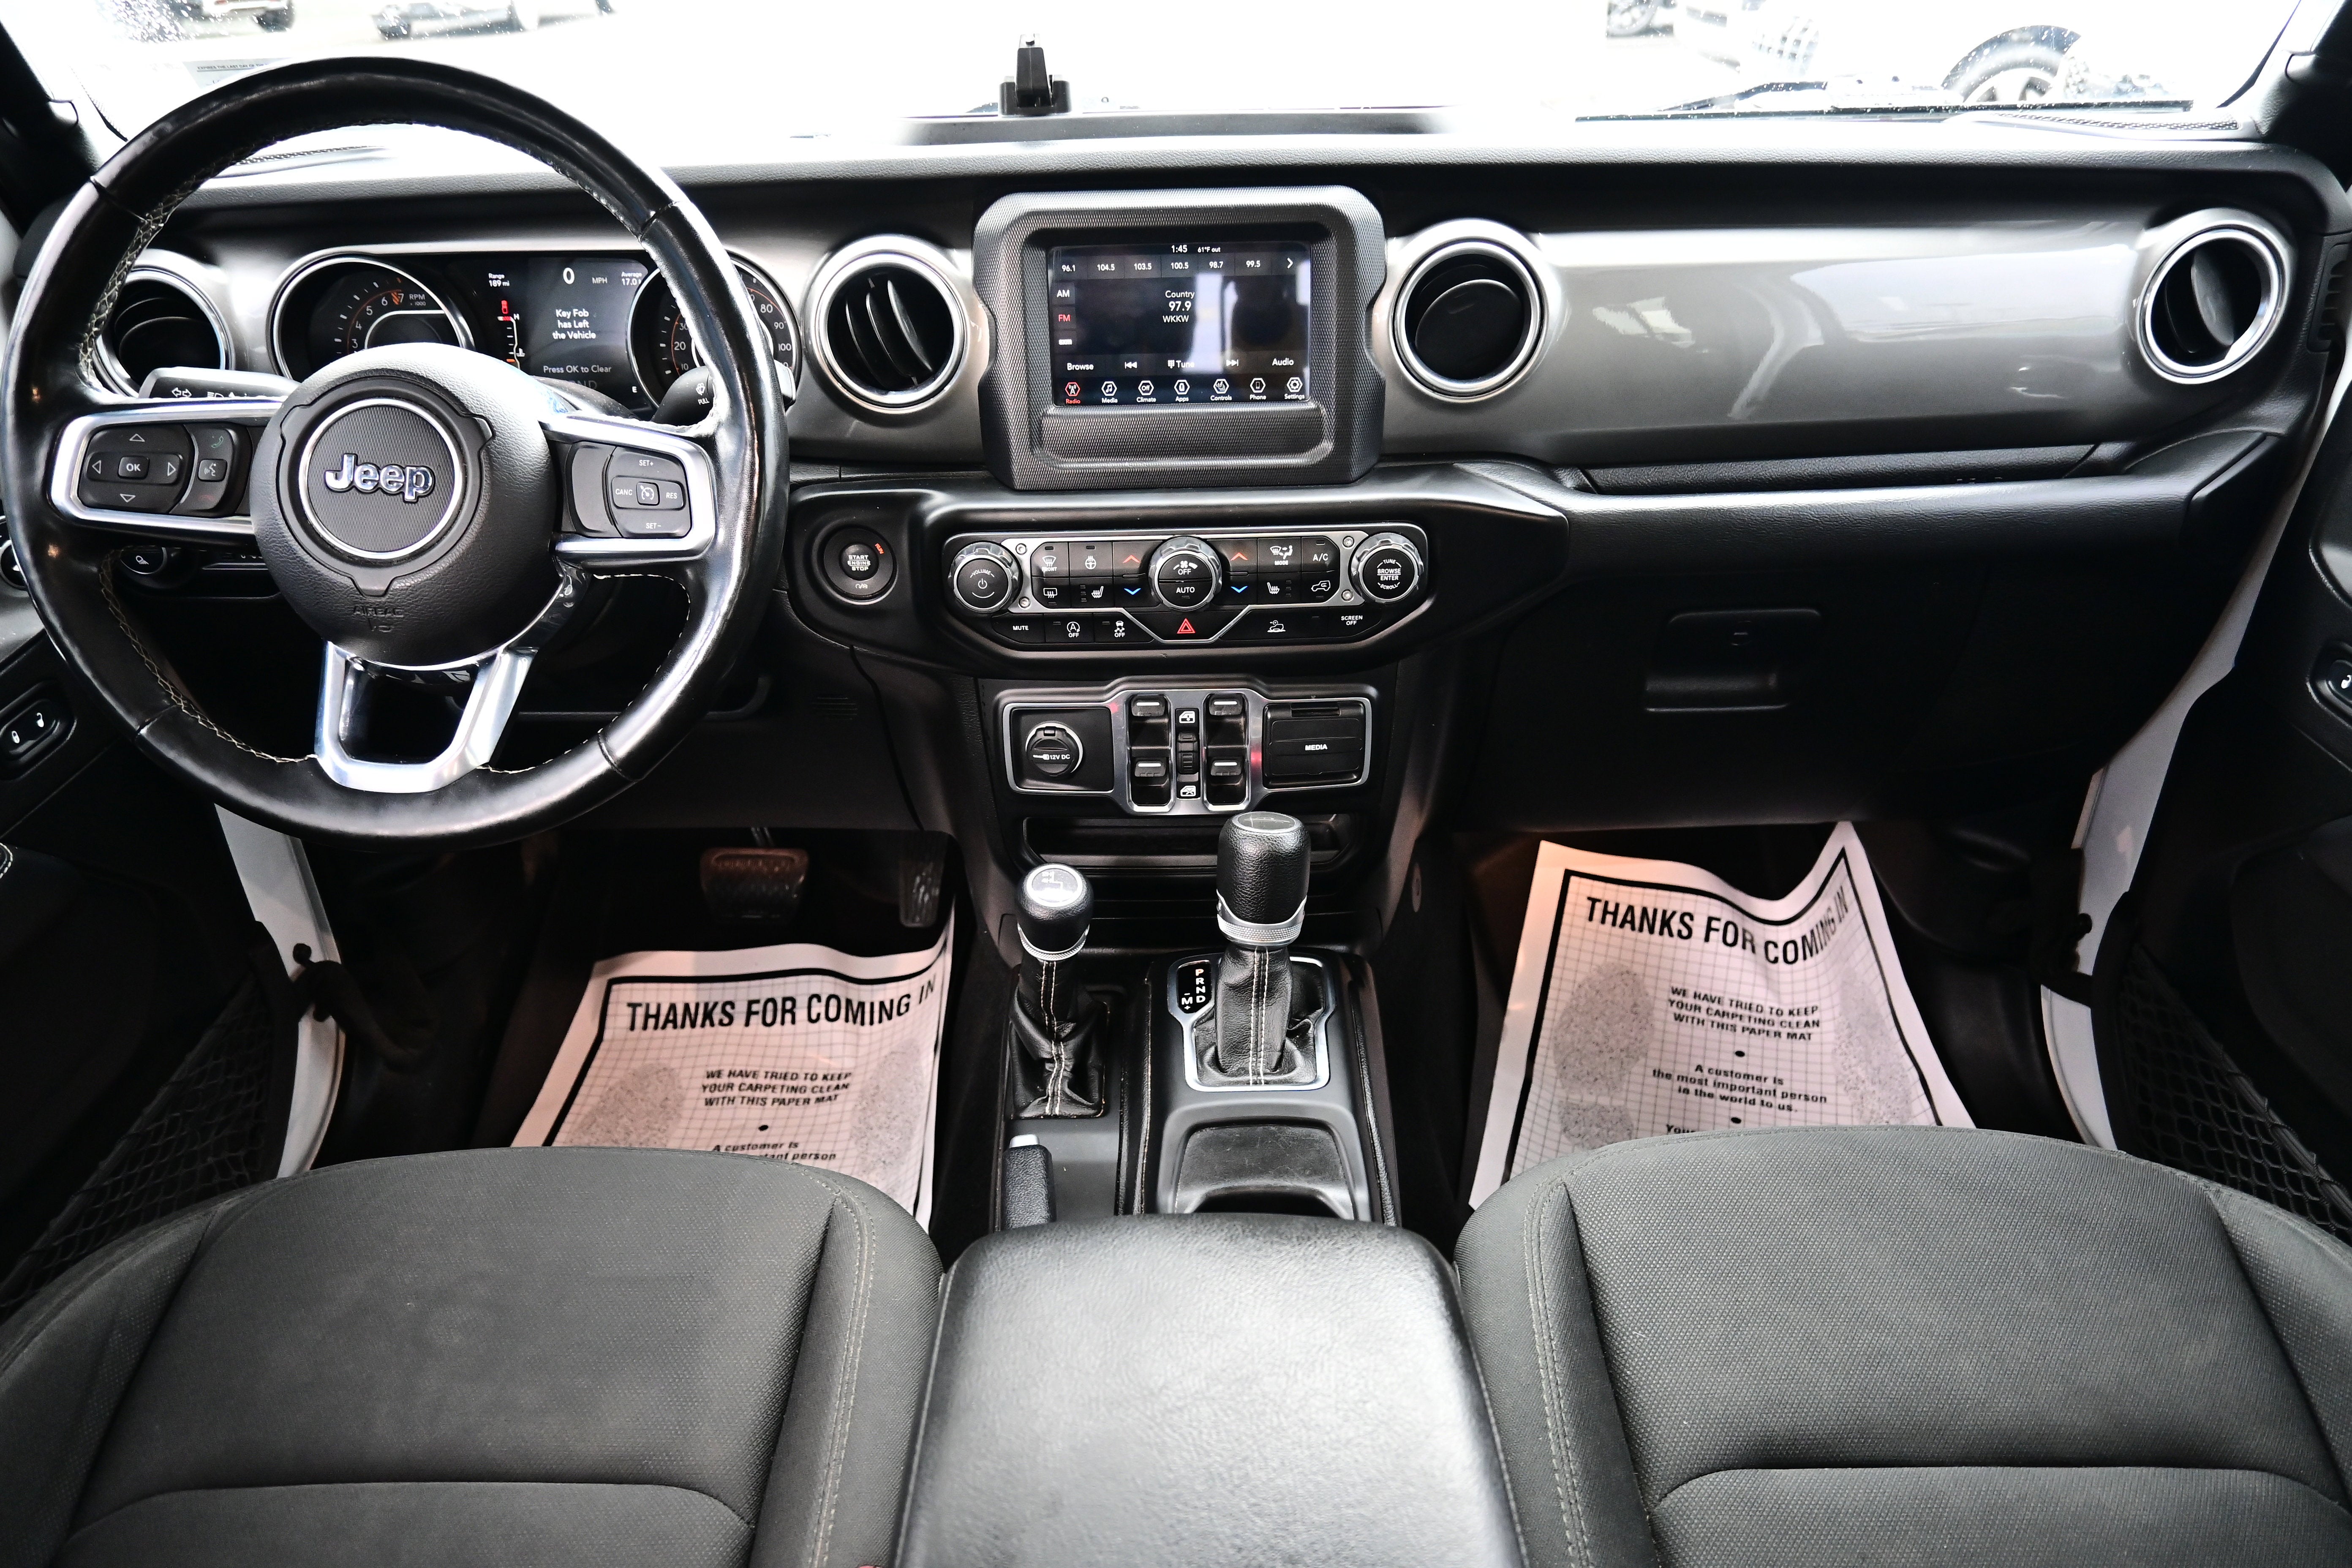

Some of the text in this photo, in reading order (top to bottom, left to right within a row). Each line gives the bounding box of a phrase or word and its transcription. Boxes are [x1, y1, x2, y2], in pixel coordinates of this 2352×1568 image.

[1171, 245, 1187, 253] 1:45
[563, 267, 574, 284] 0
[1165, 290, 1195, 299] Country
[381, 297, 388, 306] 6
[1168, 301, 1192, 311] 97.9
[366, 306, 373, 316] 5
[555, 308, 589, 319] Key Fob
[760, 304, 773, 313] 80
[356, 321, 362, 330] 4
[558, 319, 589, 329] has Left
[567, 331, 596, 340] Vehicle
[351, 339, 358, 348] 3
[674, 341, 686, 351] 20
[1272, 358, 1294, 366] Audio
[543, 366, 564, 374] Press
[591, 365, 611, 373] Clear
[126, 463, 141, 472] OK
[324, 454, 434, 502] Jeep
[875, 543, 885, 554] RUN
[1312, 553, 1328, 561] A/C
[1587, 896, 1694, 940] THANKS
[1704, 915, 1756, 955] FOR
[1764, 906, 1836, 965] COMING
[627, 973, 936, 1031] THANKS FOR COMING IN
[1181, 996, 1192, 1005] M
[1671, 986, 1818, 1017] WE HAVE TRIED TO KEEP
[1668, 999, 1820, 1028] YOUR CARPETING CLEAN
[1674, 1013, 1813, 1041] WITH THIS PAPER MAT
[706, 1070, 852, 1081] WE HAVE TRIED TO KEEP
[1695, 1064, 1784, 1086] A customer is
[702, 1083, 850, 1094] YOUR CARPETING CLEAN
[1652, 1069, 1827, 1103] the most important person
[705, 1094, 839, 1106] WITH THIS PAPER MAT
[1678, 1086, 1690, 1094] in
[1694, 1088, 1714, 1099] the
[1719, 1093, 1756, 1106] world
[1760, 1099, 1773, 1109] to
[1666, 1124, 1696, 1134] You
[725, 1142, 784, 1152] customer
[792, 1152, 836, 1161] person
